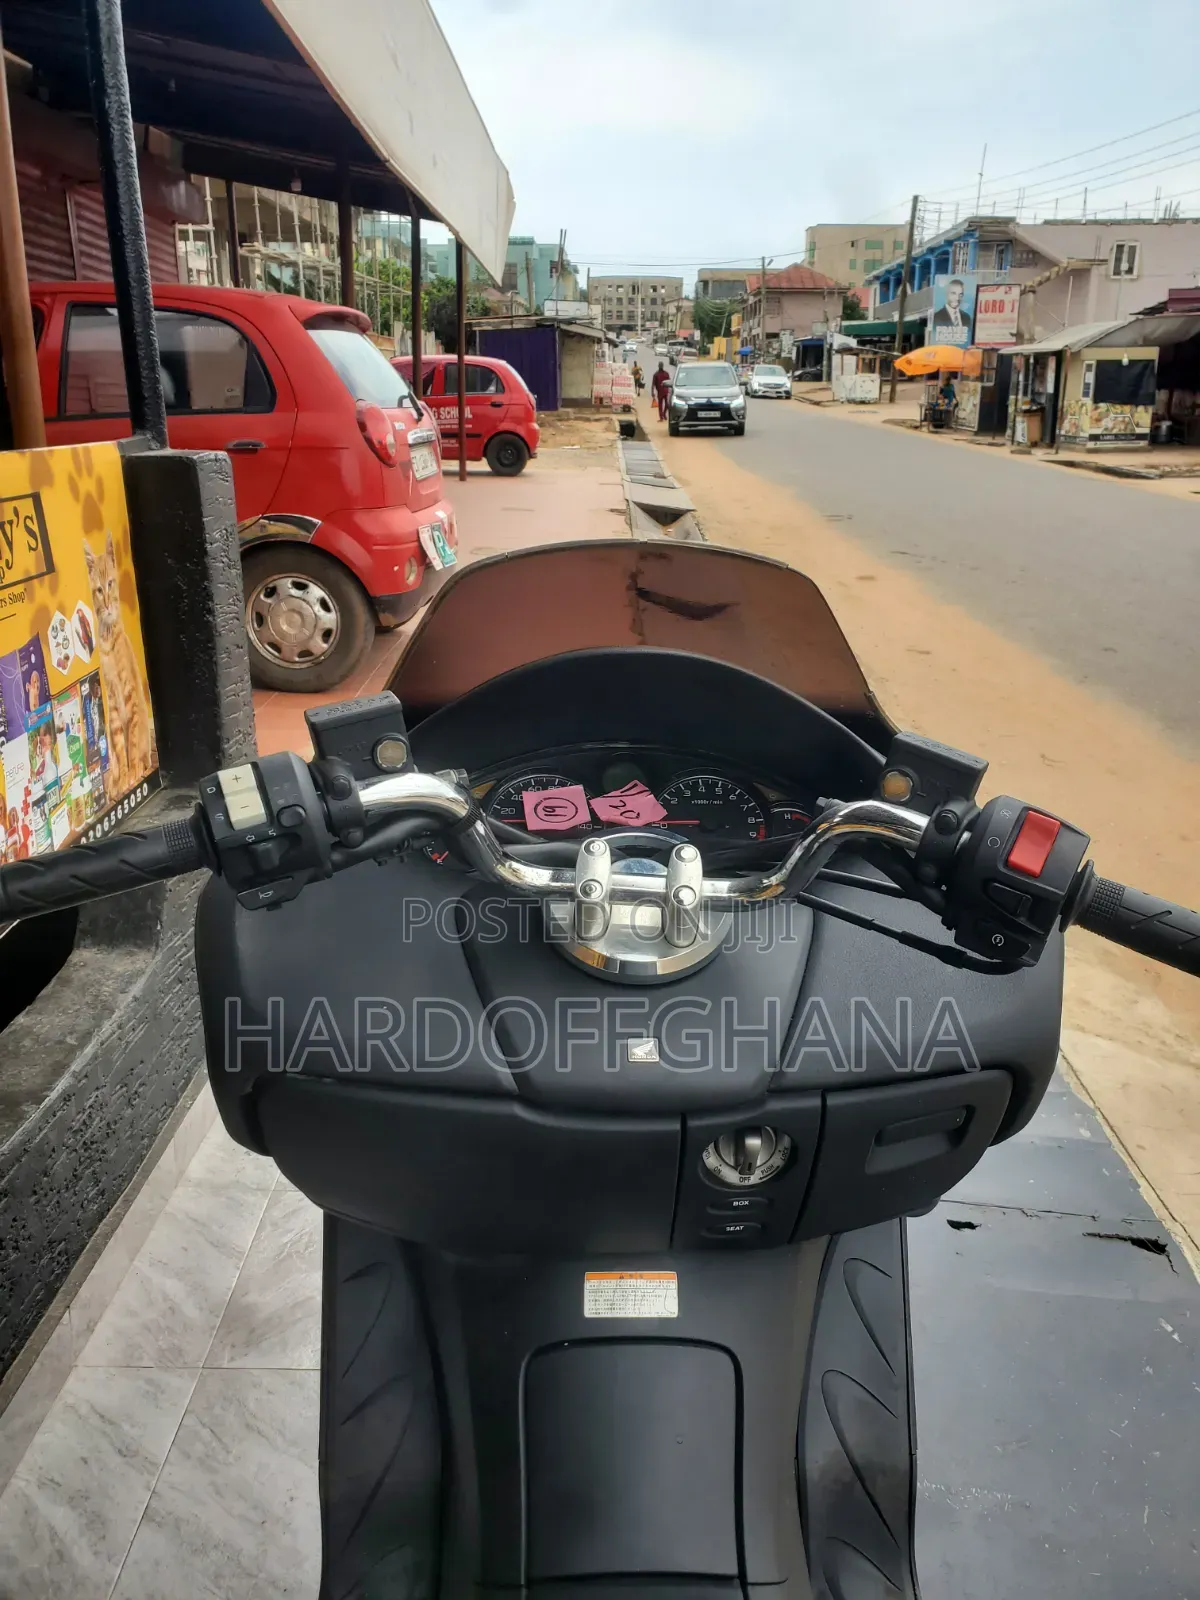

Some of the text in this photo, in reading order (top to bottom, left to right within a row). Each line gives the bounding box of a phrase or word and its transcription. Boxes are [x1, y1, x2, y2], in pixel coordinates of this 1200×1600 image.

[979, 299, 1005, 314] LORD
[440, 406, 472, 420] SCHL
[0, 505, 39, 571] y's
[206, 786, 217, 795] D
[682, 789, 691, 797] 3
[698, 785, 706, 793] 4
[715, 787, 723, 795] 5
[670, 797, 679, 805] 2
[728, 793, 737, 801] 6
[500, 807, 516, 815] 20
[740, 804, 748, 812] 7
[747, 816, 756, 825] 8
[780, 1147, 789, 1161] LOCK
[713, 1166, 722, 1175] ON
[761, 1164, 774, 1175] PUSH
